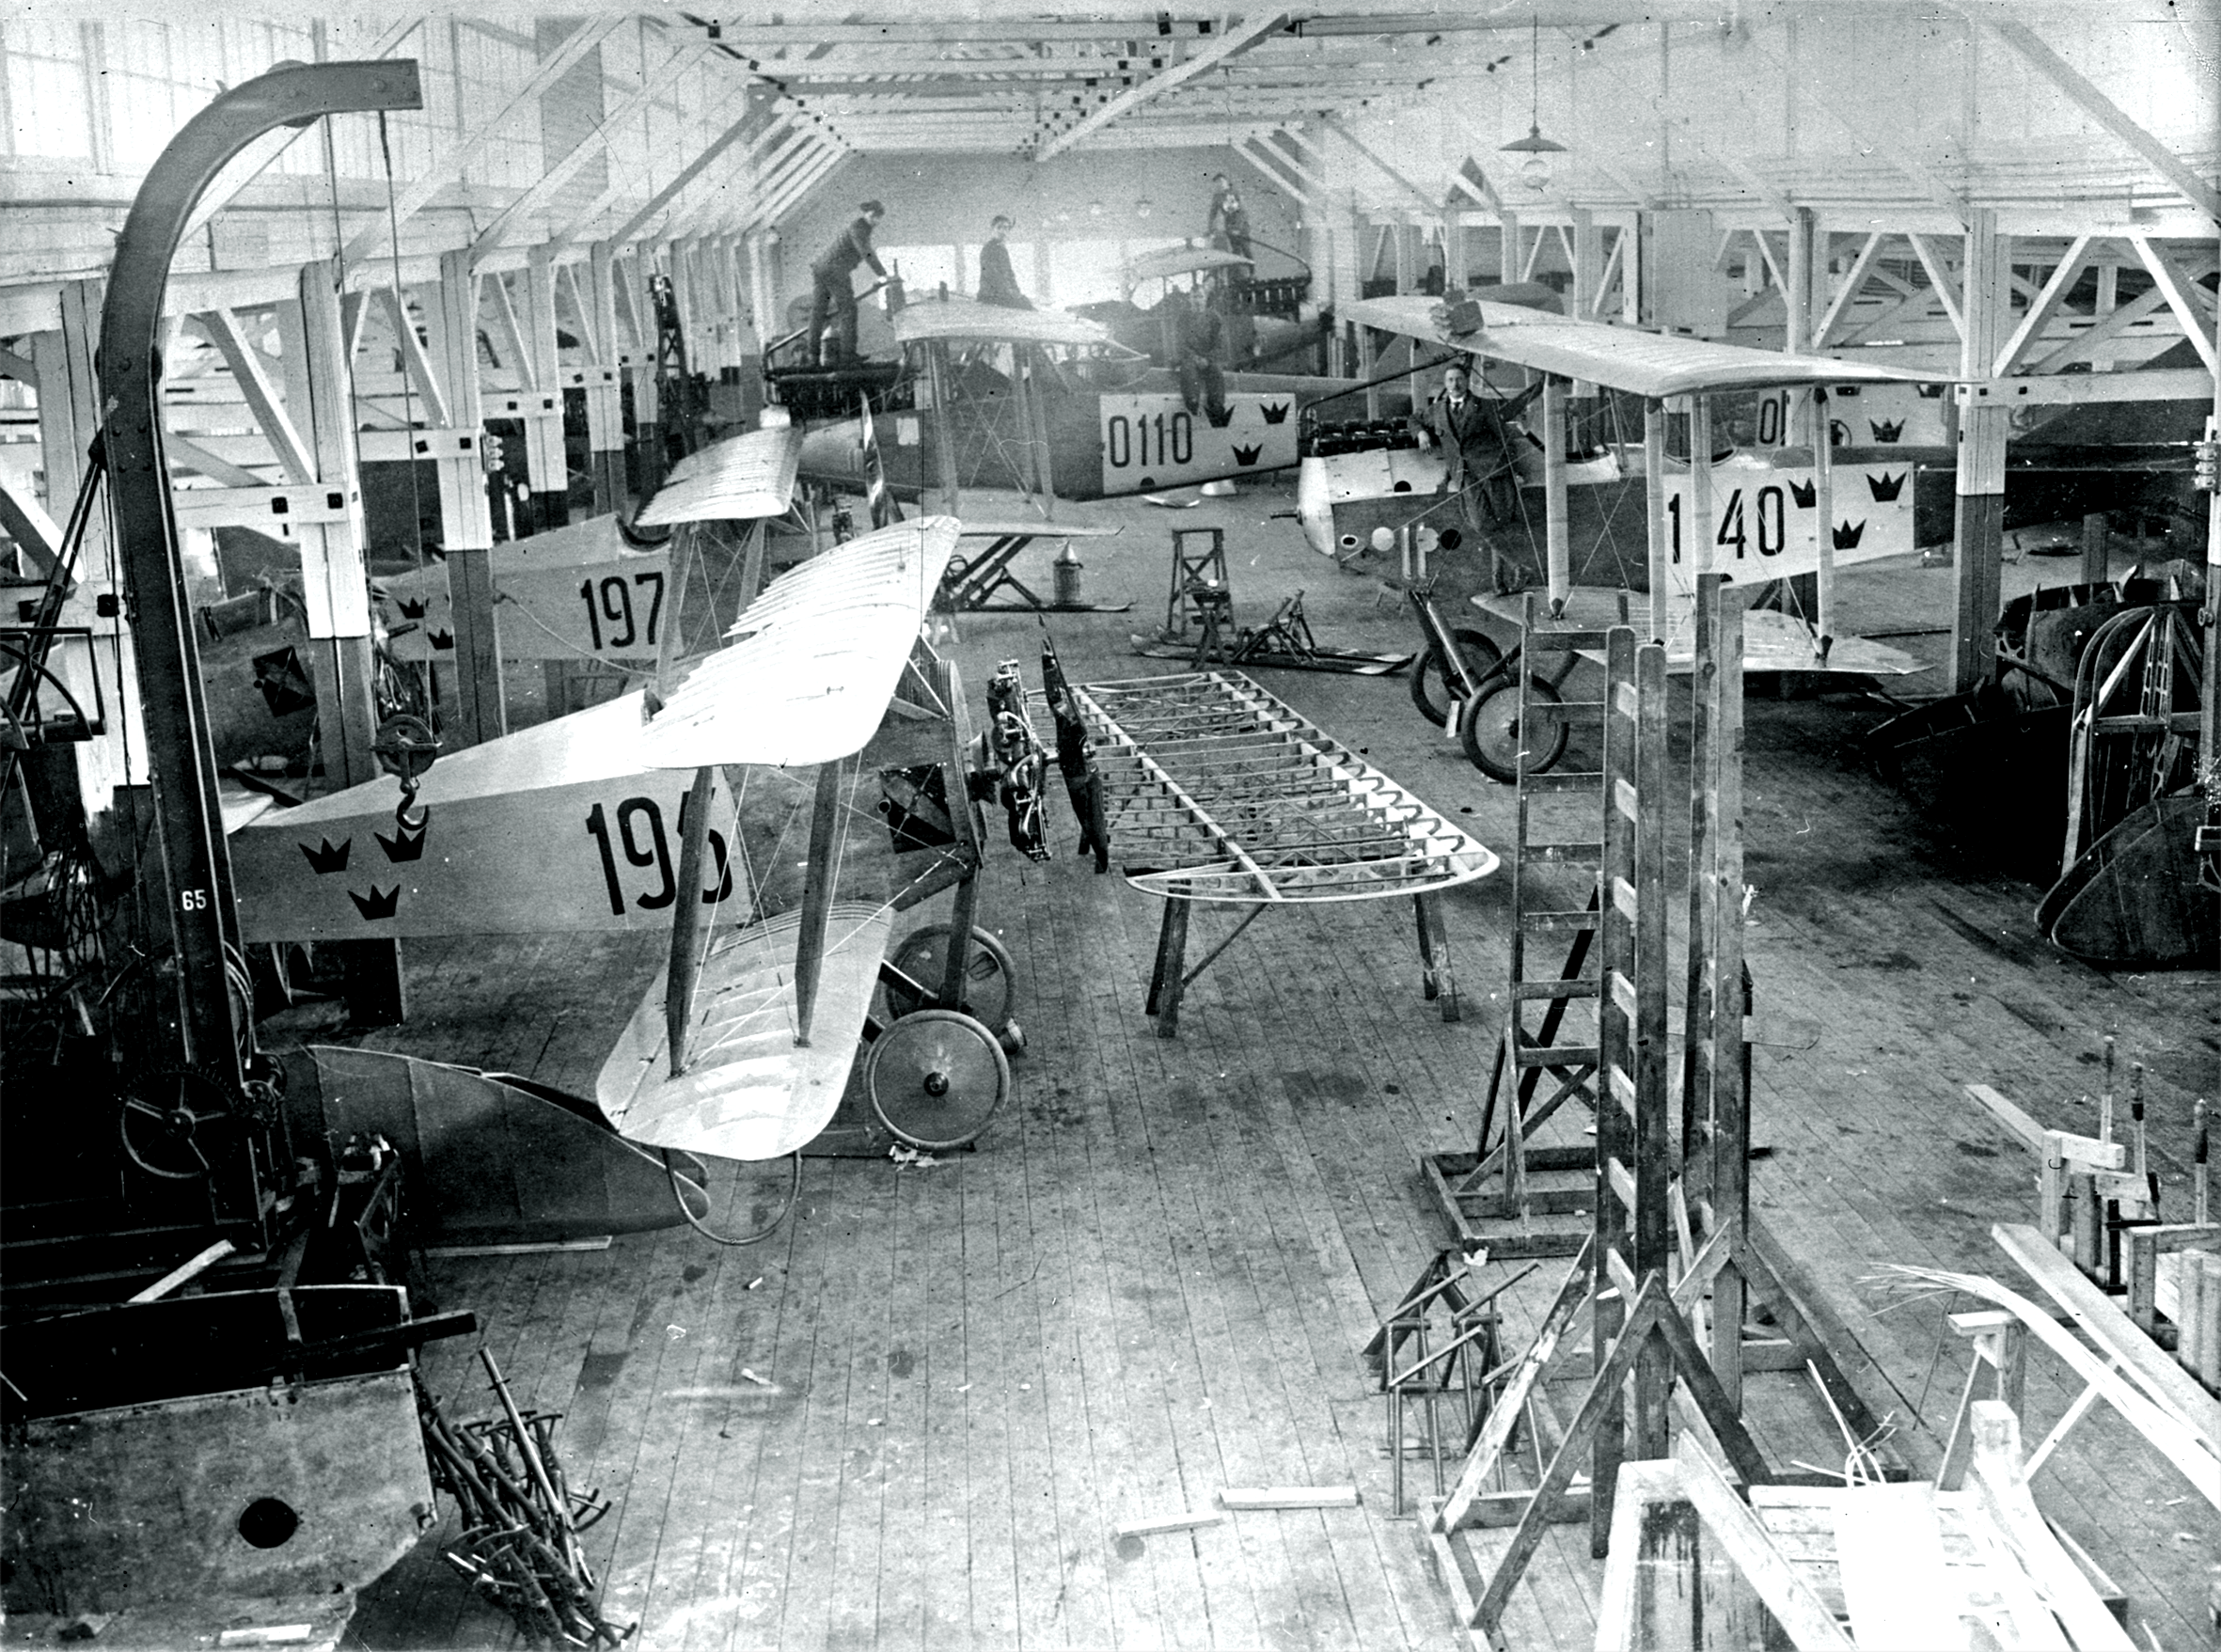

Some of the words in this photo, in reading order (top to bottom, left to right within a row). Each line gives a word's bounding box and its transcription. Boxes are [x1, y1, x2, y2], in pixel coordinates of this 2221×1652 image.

[1109, 412, 1192, 468] 0110
[580, 571, 664, 650] 197
[181, 889, 207, 911] 65
